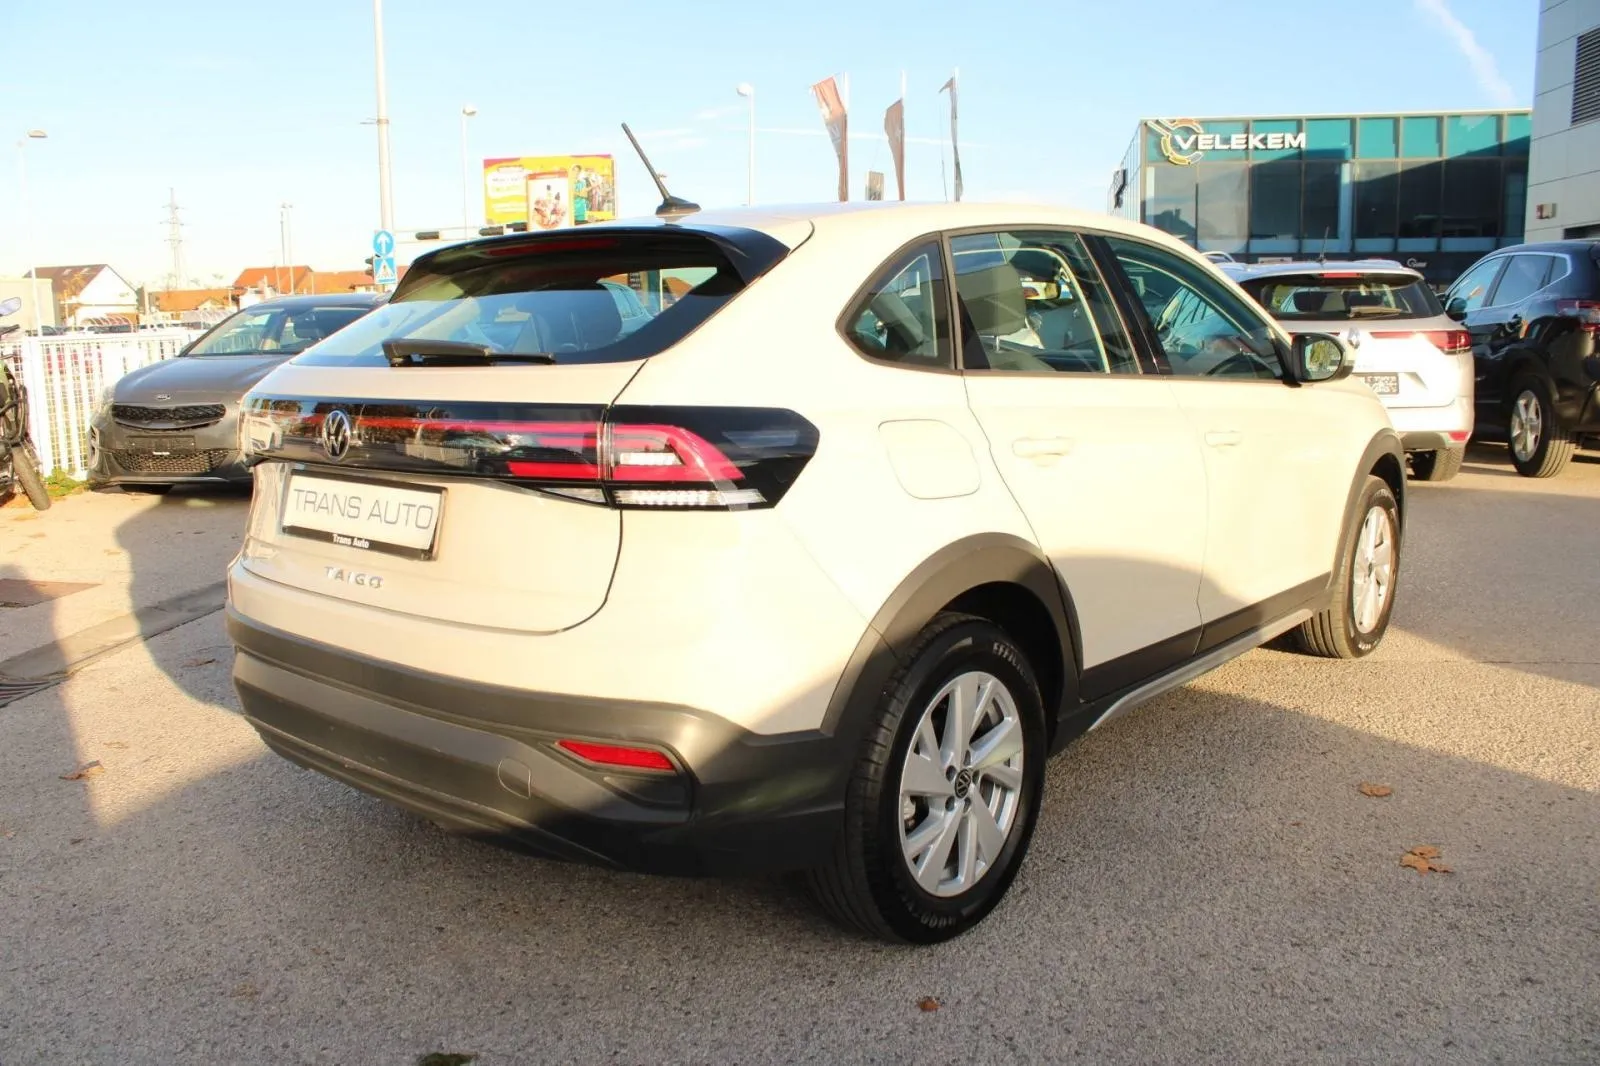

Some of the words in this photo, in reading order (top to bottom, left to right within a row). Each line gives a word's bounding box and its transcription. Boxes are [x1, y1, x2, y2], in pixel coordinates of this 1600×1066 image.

[1174, 132, 1306, 150] VELEKEM
[293, 488, 362, 519] TRANS
[367, 499, 433, 530] AUTO
[333, 533, 352, 545] Trans
[352, 537, 370, 549] Auto
[324, 566, 384, 589] TAIGO
